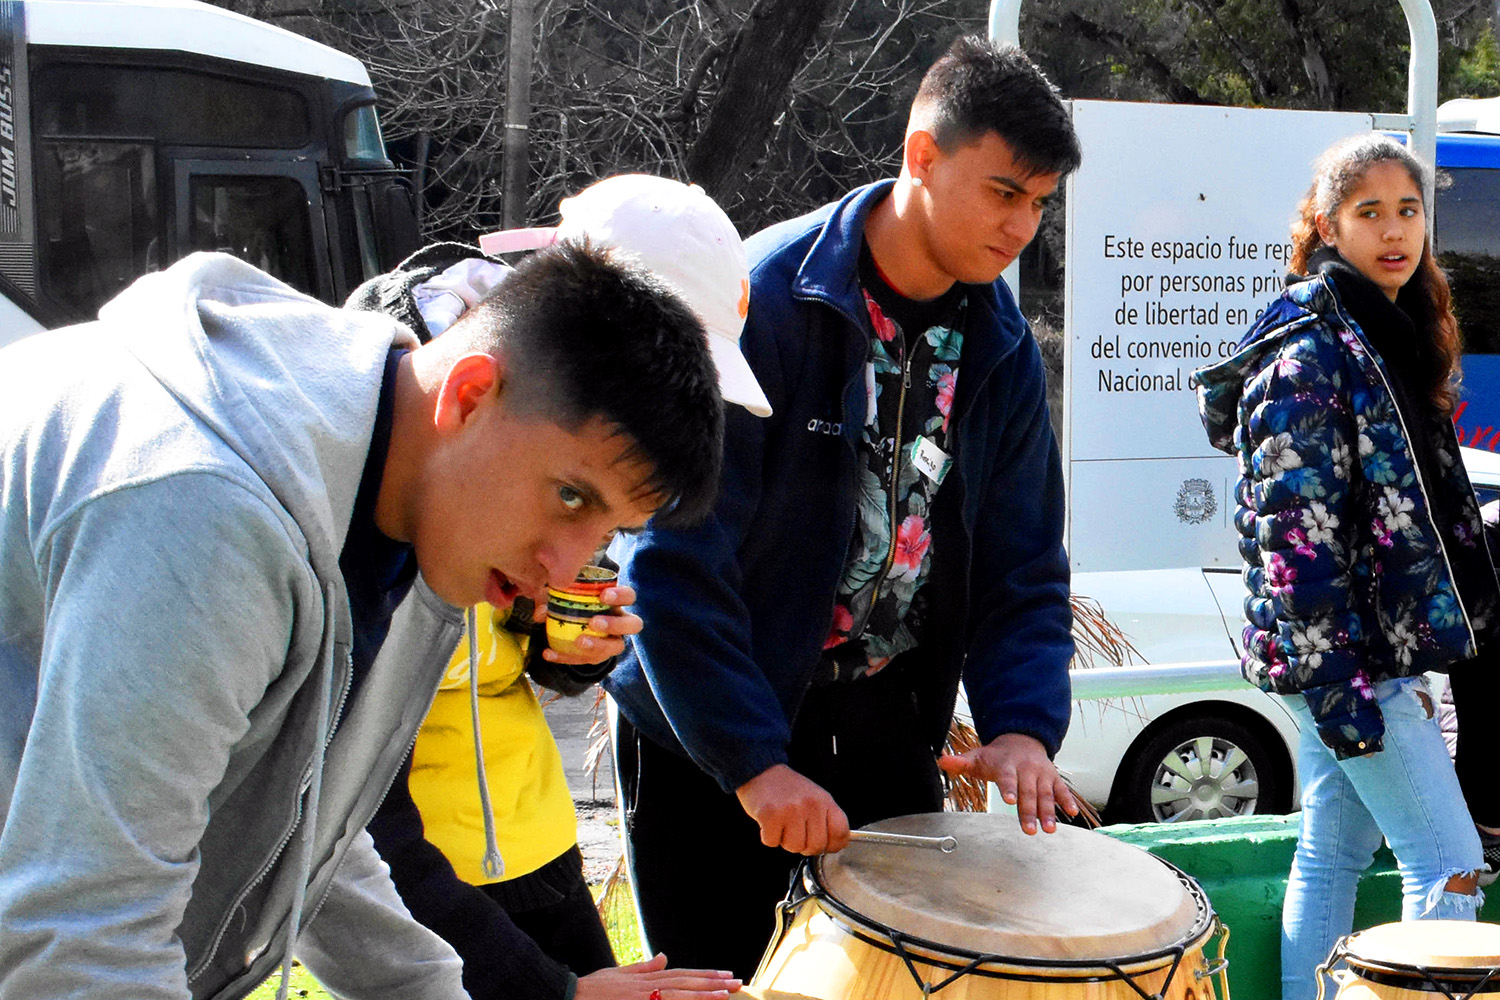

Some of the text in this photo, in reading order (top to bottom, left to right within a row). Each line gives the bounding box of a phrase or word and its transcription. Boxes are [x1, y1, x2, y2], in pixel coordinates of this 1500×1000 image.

[2, 147, 17, 207] JUM
[1104, 235, 1144, 259] Este
[1151, 235, 1222, 264] espacio
[1228, 235, 1258, 259] fue
[1121, 274, 1154, 298] por
[1160, 273, 1245, 299] personas
[1115, 302, 1270, 325] de libertad en e
[1091, 335, 1120, 359] del
[1127, 335, 1211, 358] convenio
[1098, 369, 1182, 392] Nacional
